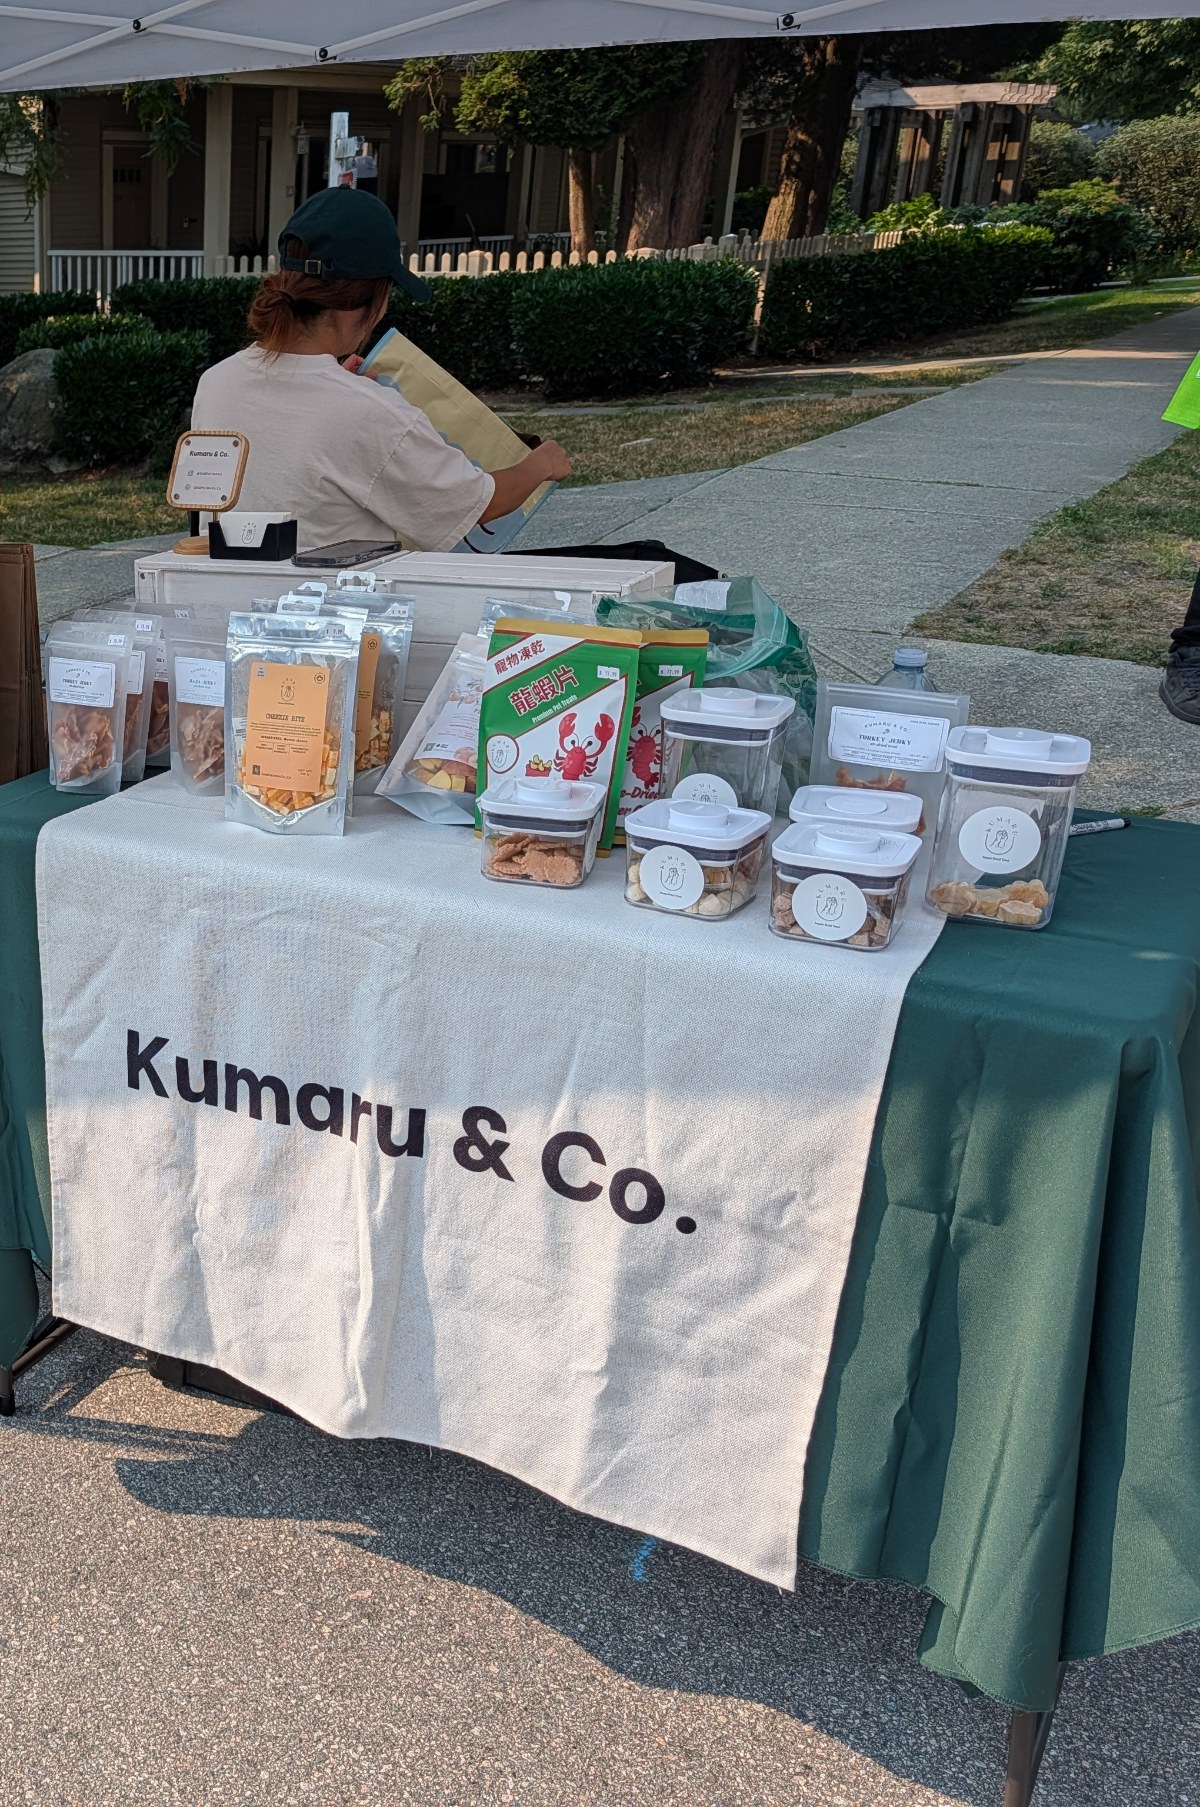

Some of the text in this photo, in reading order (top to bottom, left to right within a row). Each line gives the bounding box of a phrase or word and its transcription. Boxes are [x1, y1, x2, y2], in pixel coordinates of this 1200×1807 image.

[508, 664, 579, 717] 龍蝦片
[531, 708, 554, 724] Premium
[562, 694, 578, 707] Treats
[290, 715, 306, 723] BITE
[864, 721, 891, 729] KUMARU
[899, 725, 909, 734] CO.
[491, 739, 510, 754] KUMARU
[858, 733, 912, 746] TURKEY JERKY
[985, 817, 1019, 836] KUMARU
[816, 883, 847, 903] KUMARU
[126, 1028, 697, 1235] Kumaru & Co.
